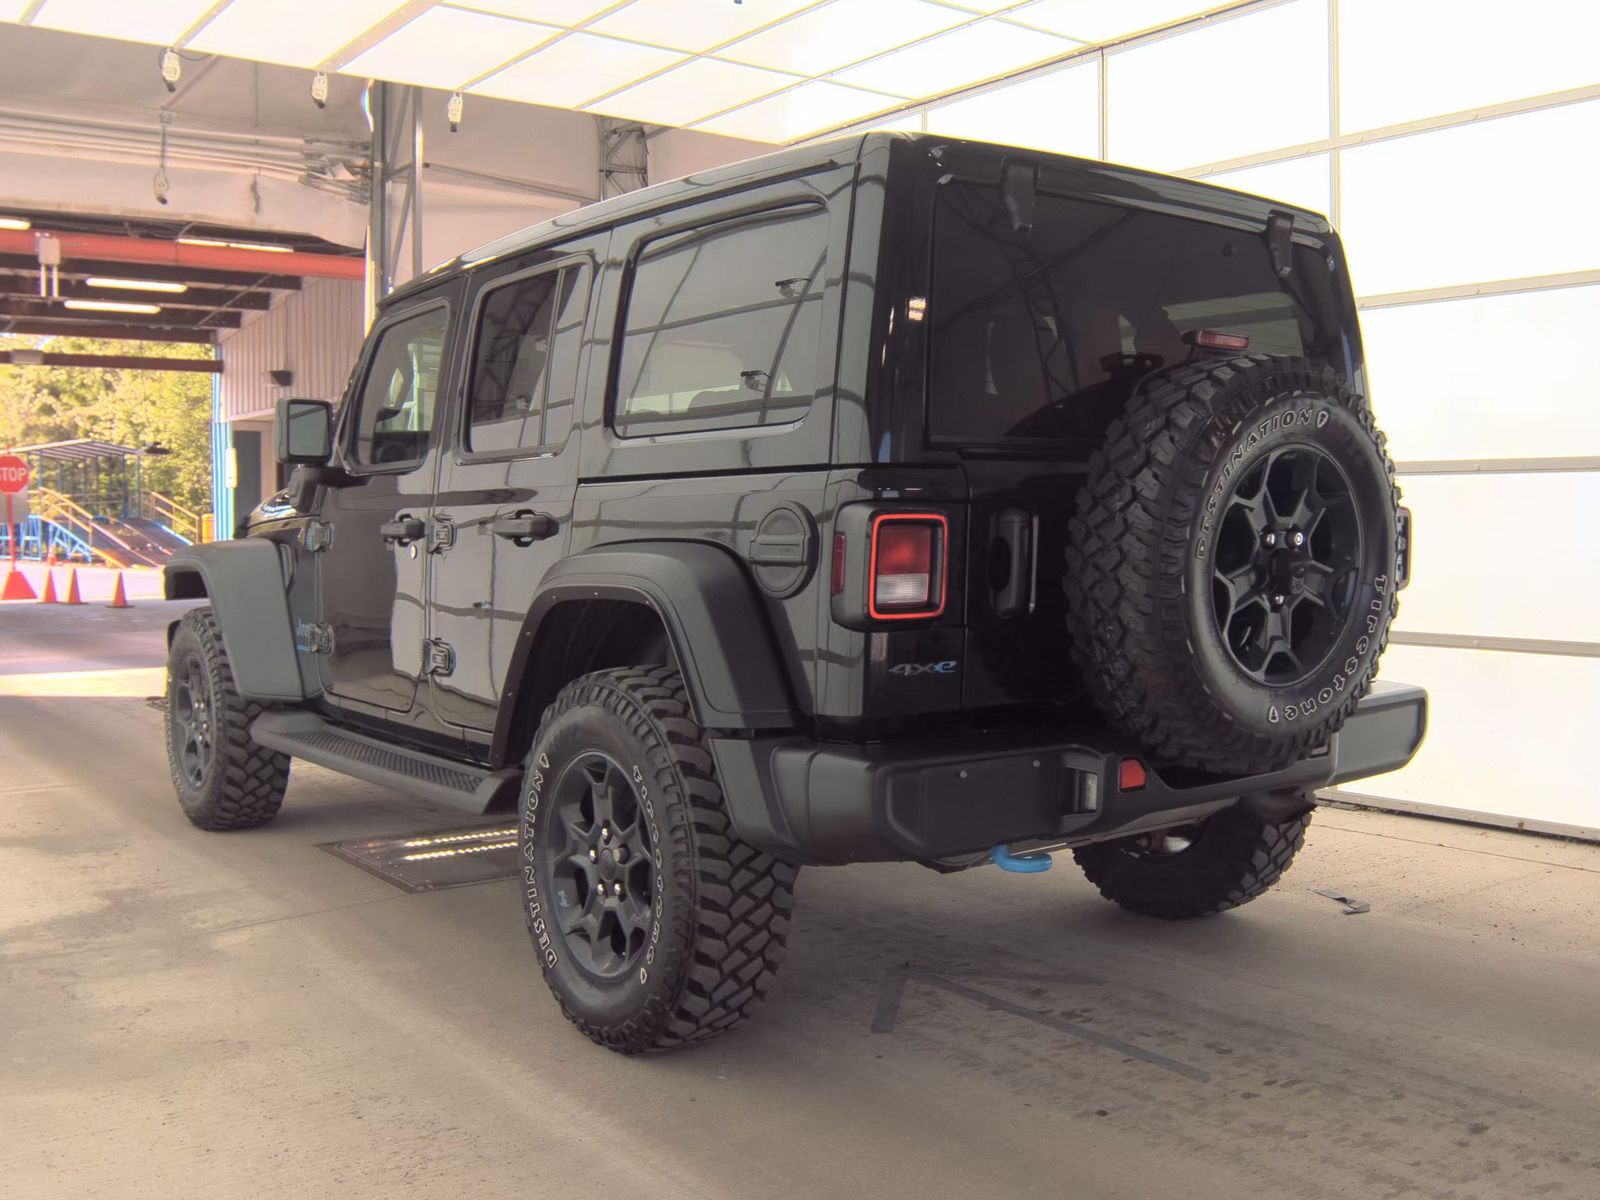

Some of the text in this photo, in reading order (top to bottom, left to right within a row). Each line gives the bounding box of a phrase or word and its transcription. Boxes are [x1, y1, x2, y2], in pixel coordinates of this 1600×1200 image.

[0, 467, 26, 482] TOP
[1196, 408, 1313, 559] DESTINATION
[1284, 574, 1388, 720] Firestone
[524, 770, 558, 968] DESTINATION
